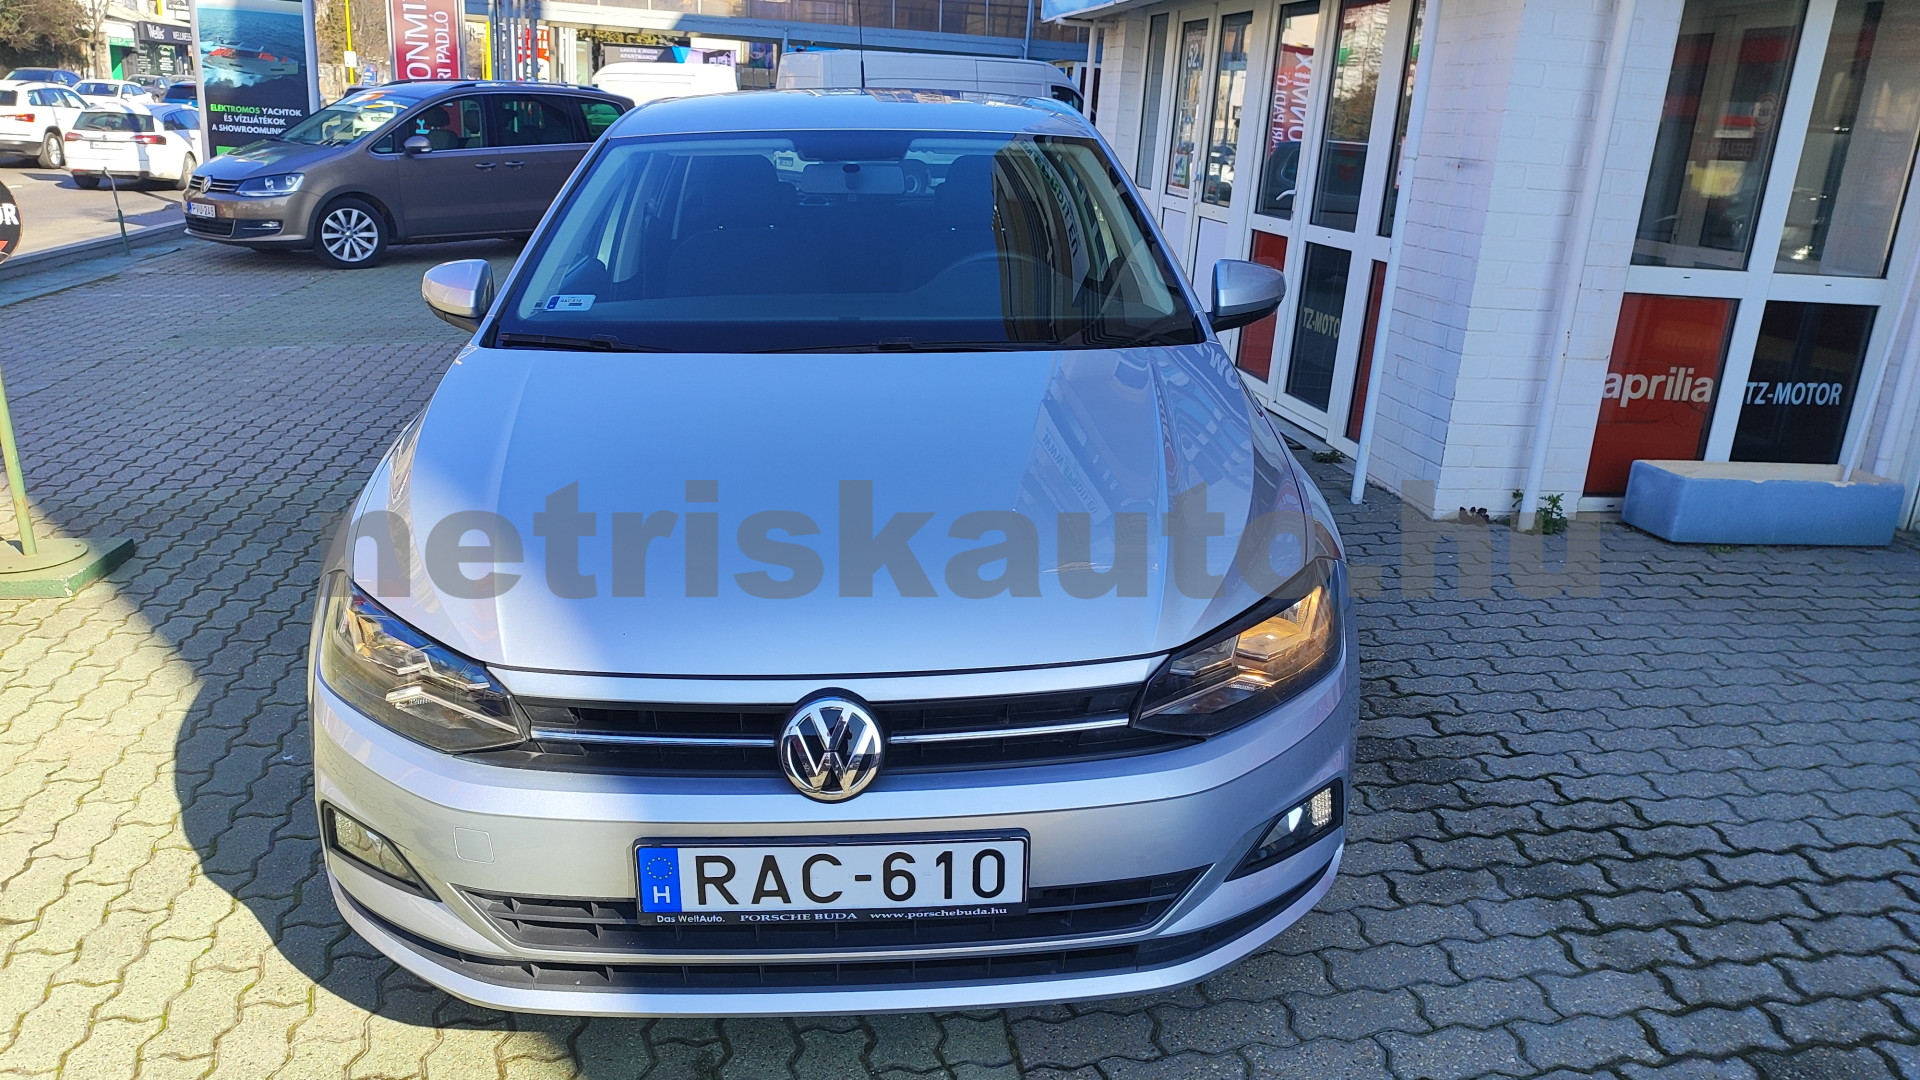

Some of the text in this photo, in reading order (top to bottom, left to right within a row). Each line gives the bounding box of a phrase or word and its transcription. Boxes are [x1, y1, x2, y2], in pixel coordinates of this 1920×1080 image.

[402, 0, 432, 79] ONMI
[429, 11, 451, 63] PADLÓ
[210, 103, 303, 117] ELEKTROMOS YACHTOK
[223, 113, 233, 122] ÉS
[1602, 366, 1714, 408] aprilia
[1746, 382, 1843, 405] TZ-MOTOR
[695, 848, 1006, 905] RAC-610
[653, 885, 671, 904] H
[656, 914, 726, 923] Das WeltAuto.
[740, 912, 858, 922] PORSCHE BUDA
[869, 907, 1007, 920] www.porschebuda.hu
